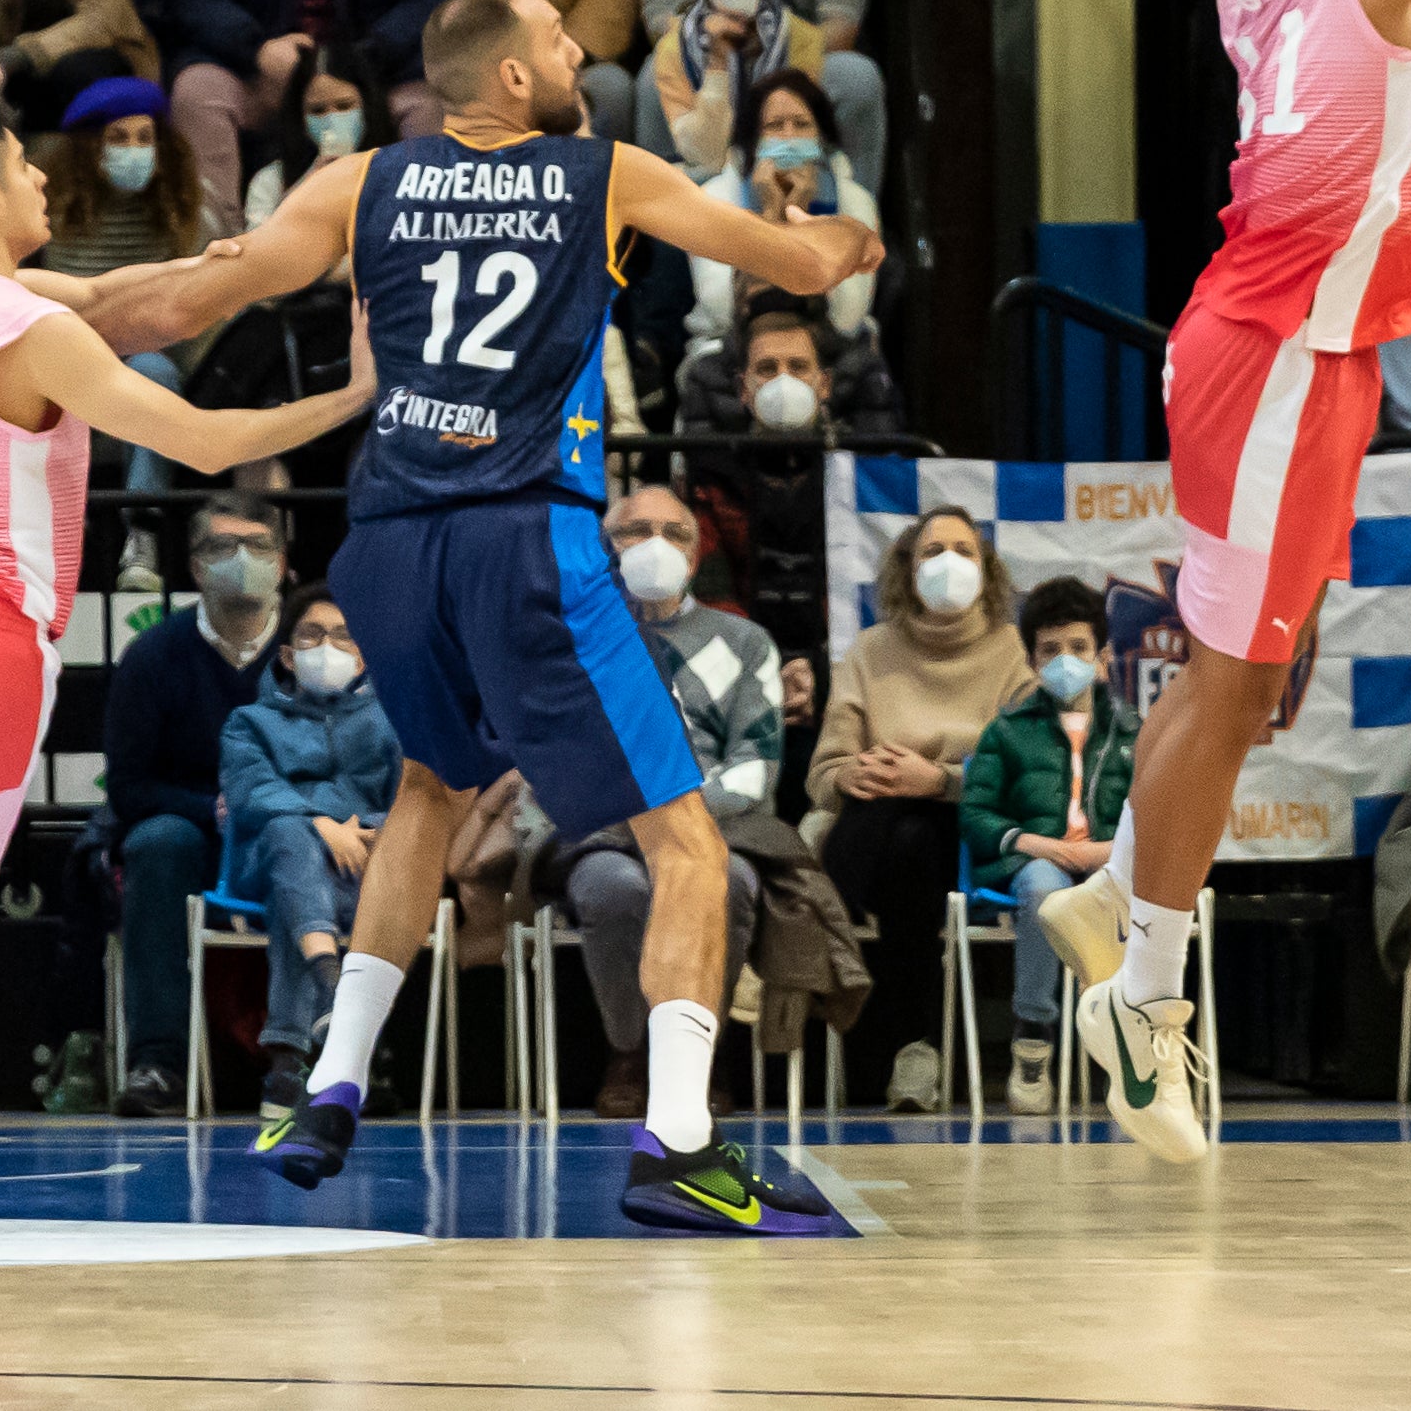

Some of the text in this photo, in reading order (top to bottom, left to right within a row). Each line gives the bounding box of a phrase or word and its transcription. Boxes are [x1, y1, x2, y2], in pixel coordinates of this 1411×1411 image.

[395, 161, 574, 203] ARTEAGA O.
[389, 210, 563, 242] ALIMERKA
[421, 249, 539, 371] 12
[402, 394, 499, 438] INTEGRA
